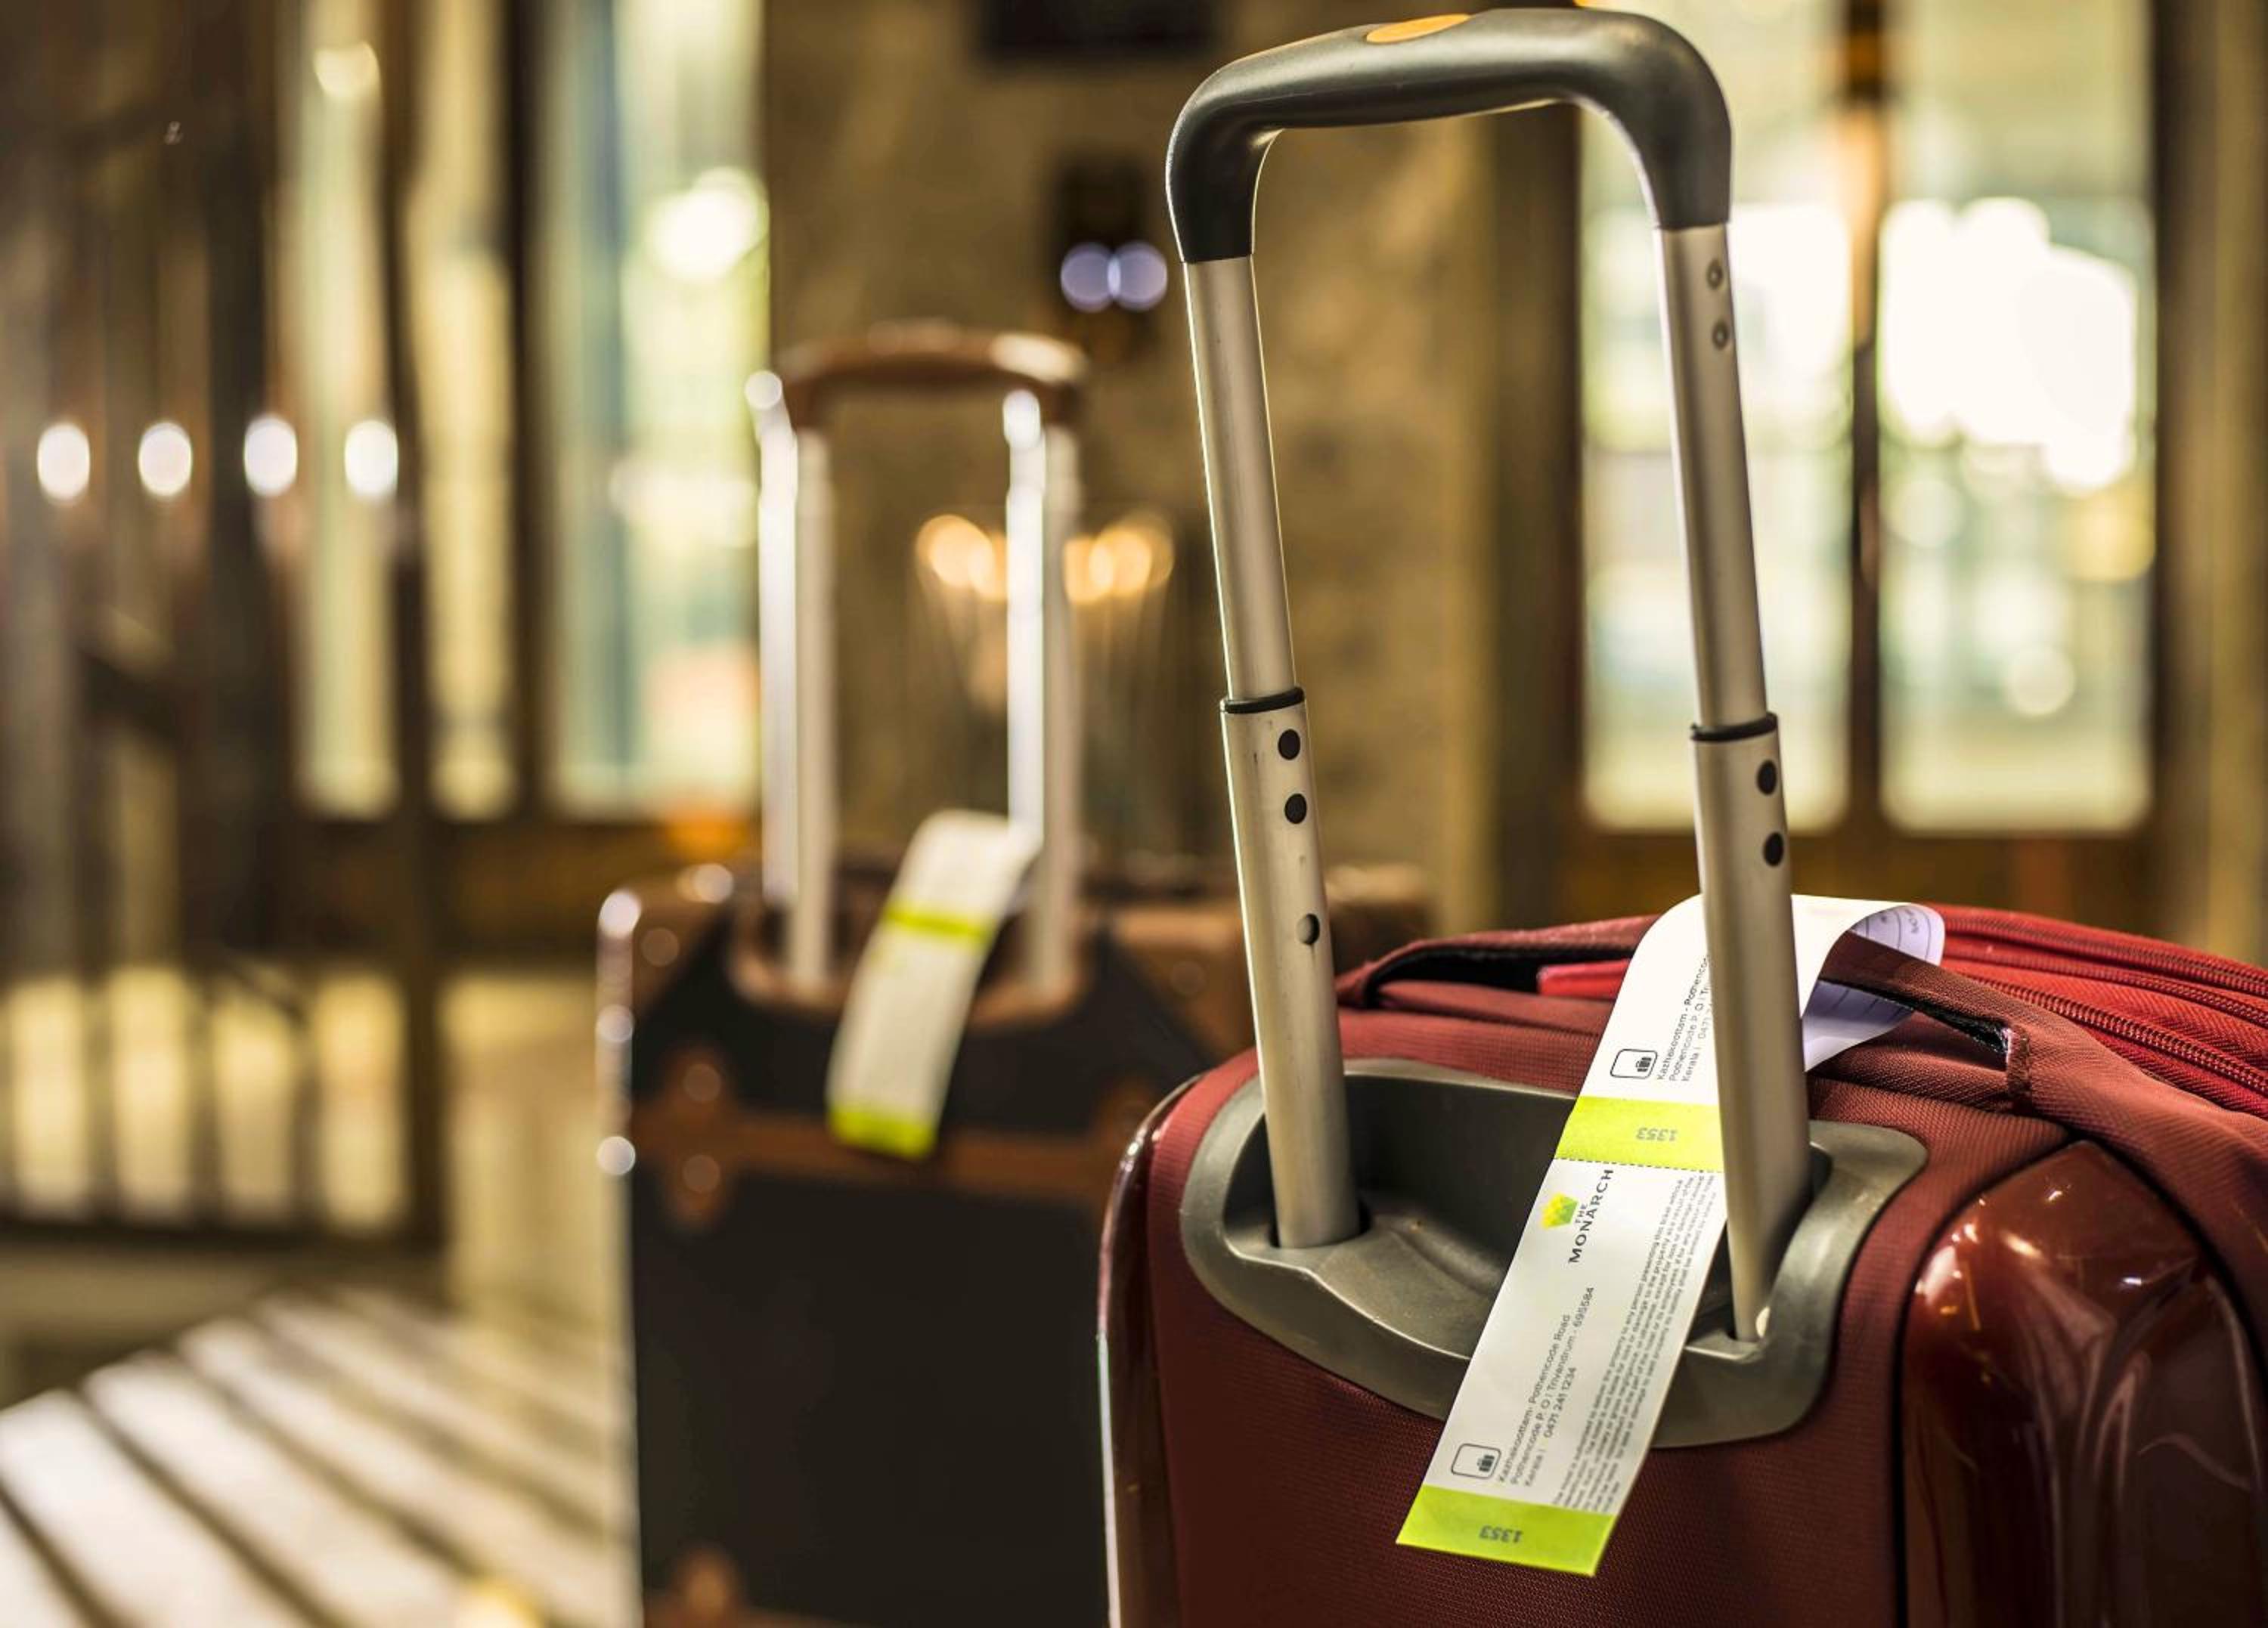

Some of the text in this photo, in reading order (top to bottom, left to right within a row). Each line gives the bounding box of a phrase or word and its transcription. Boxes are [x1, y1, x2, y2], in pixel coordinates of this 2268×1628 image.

[1635, 1127, 1678, 1142] 1353
[1566, 1168, 1614, 1264] MONARCH
[1573, 1203, 1588, 1223] THE
[1526, 1343, 1560, 1404] Pothencode
[1551, 1314, 1572, 1341] Road
[1545, 1336, 1576, 1392] Trivandrum
[1559, 1366, 1577, 1391] 1234
[1551, 1392, 1568, 1411] 241
[1479, 1524, 1524, 1543] 1353
